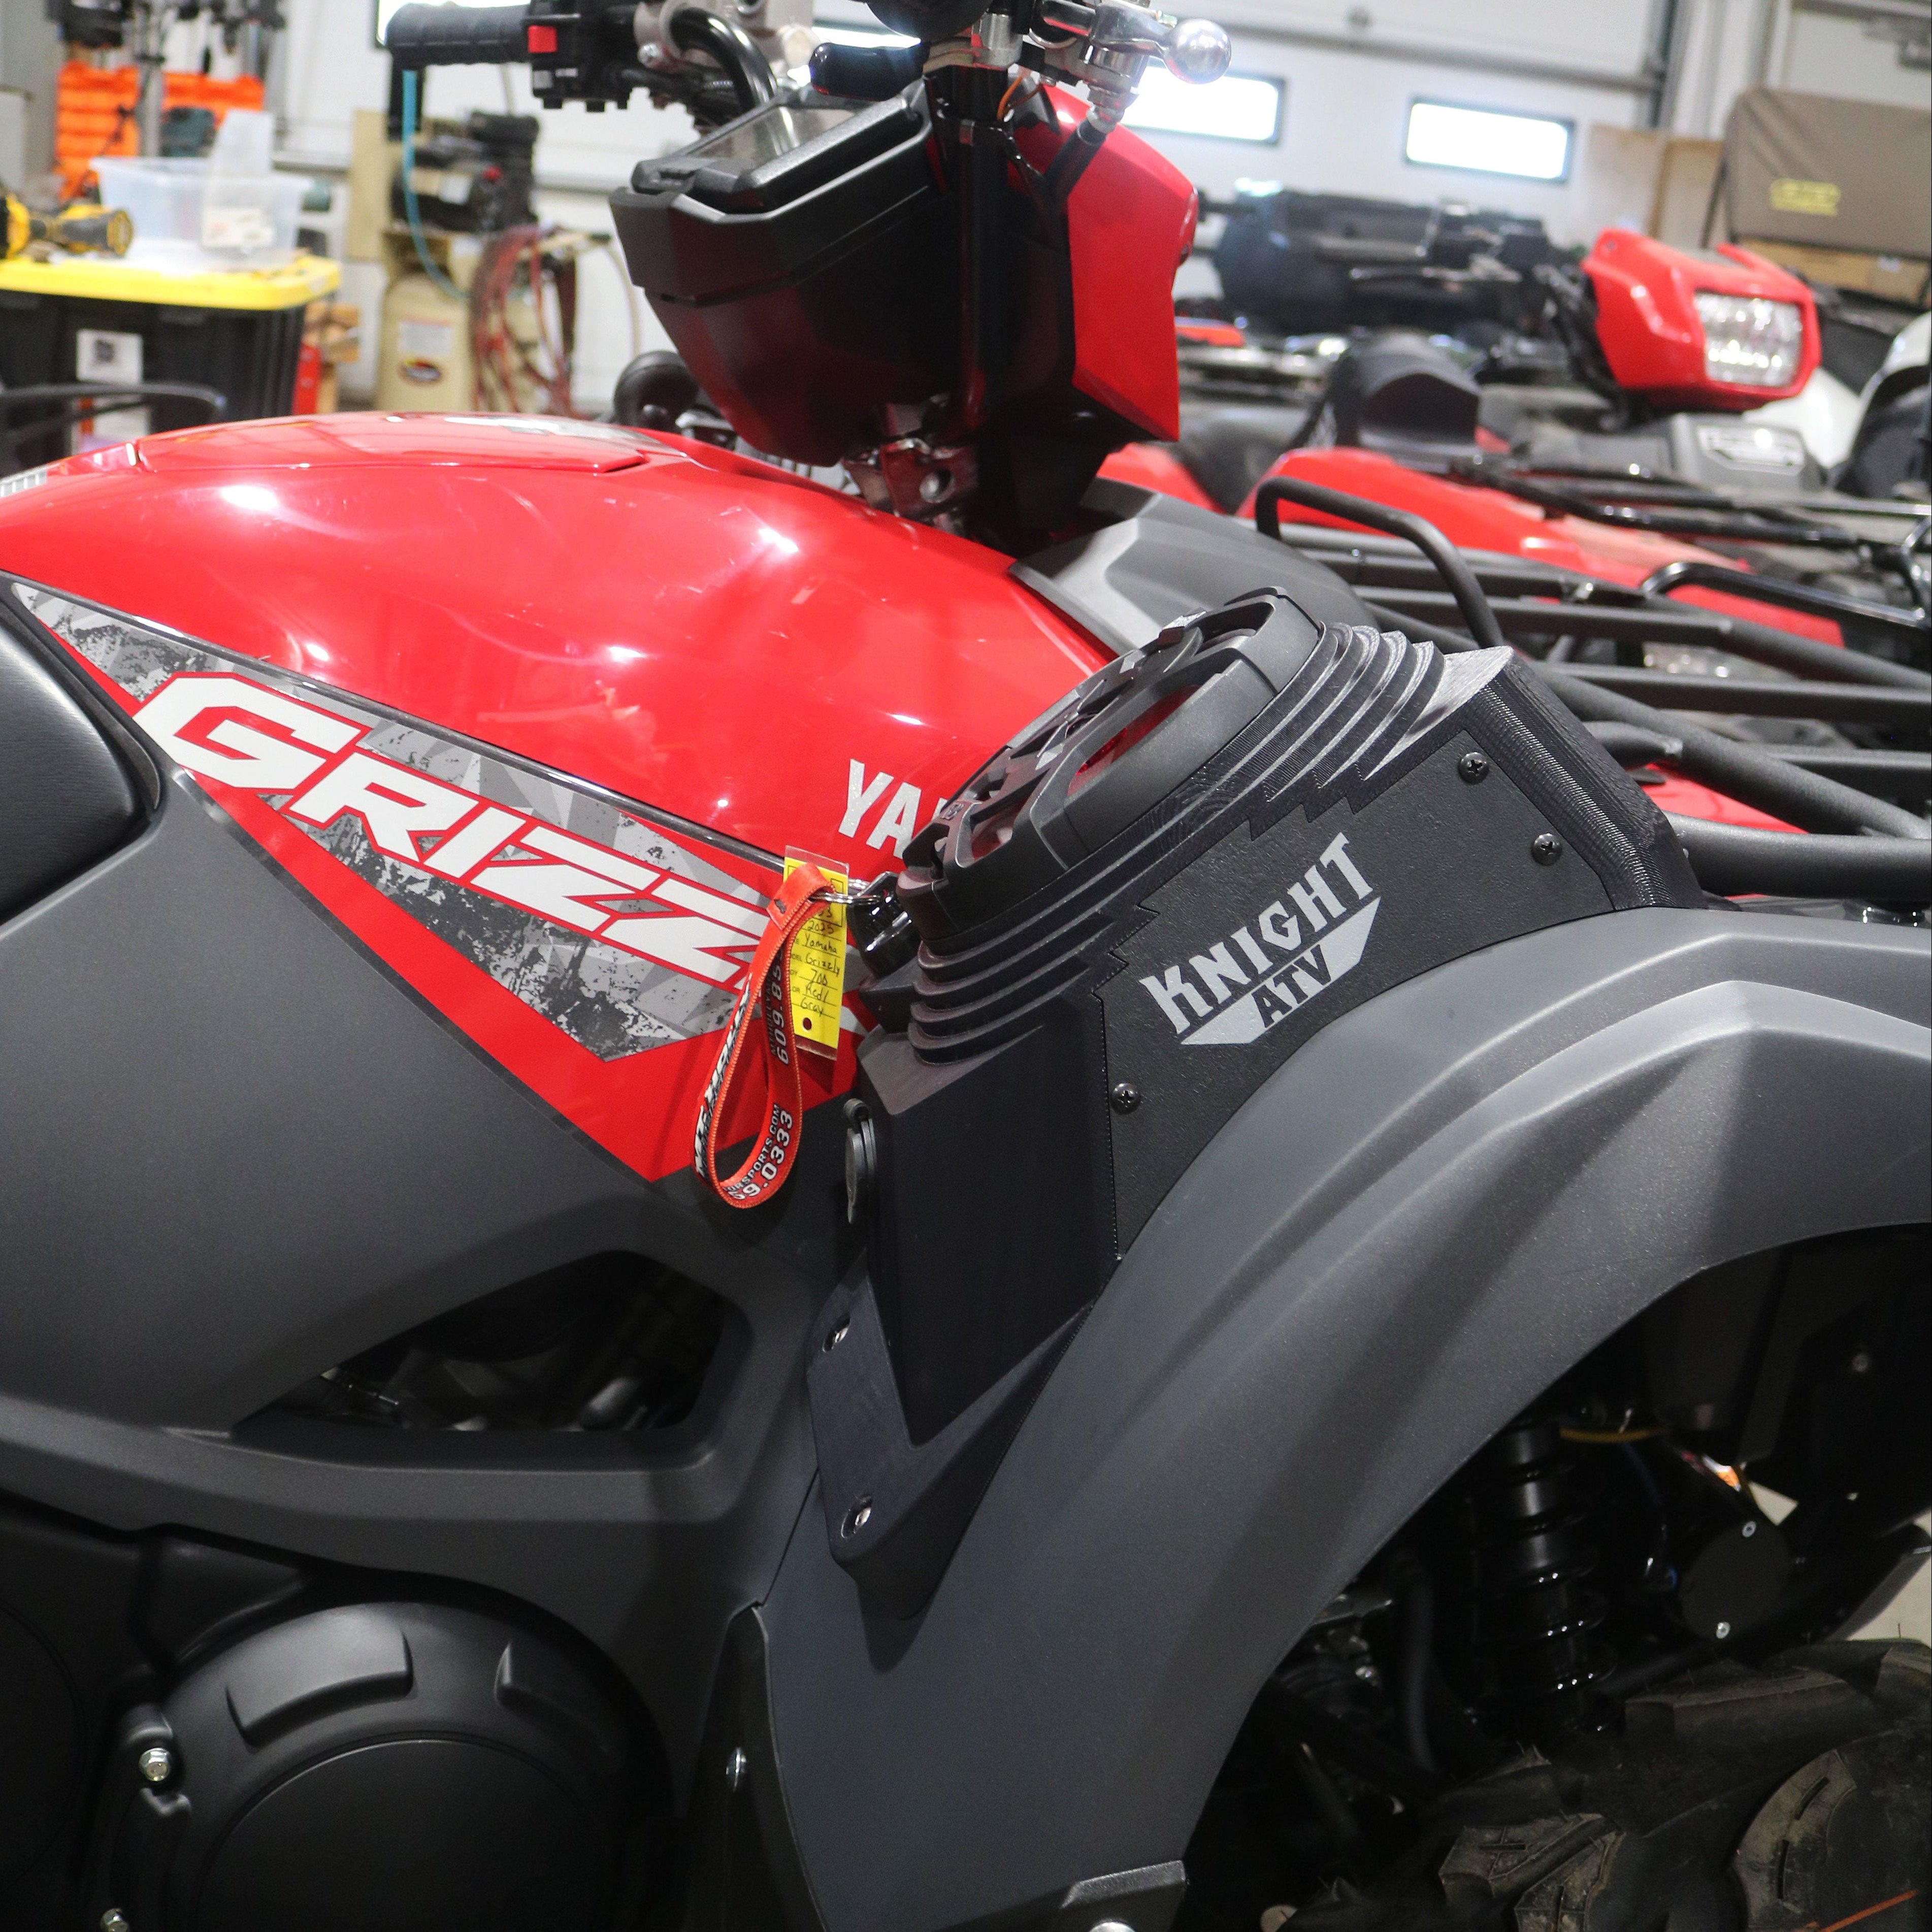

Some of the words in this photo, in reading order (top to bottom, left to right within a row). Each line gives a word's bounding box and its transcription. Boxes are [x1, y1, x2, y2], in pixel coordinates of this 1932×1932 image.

[132, 676, 770, 990] GRIZZ
[838, 758, 947, 860] YA
[804, 932, 837, 954] Yamaha
[805, 952, 840, 977] Grizzly
[1138, 831, 1374, 1034] KNIGHT
[800, 996, 824, 1017] Gray
[1251, 944, 1331, 1028] ATV
